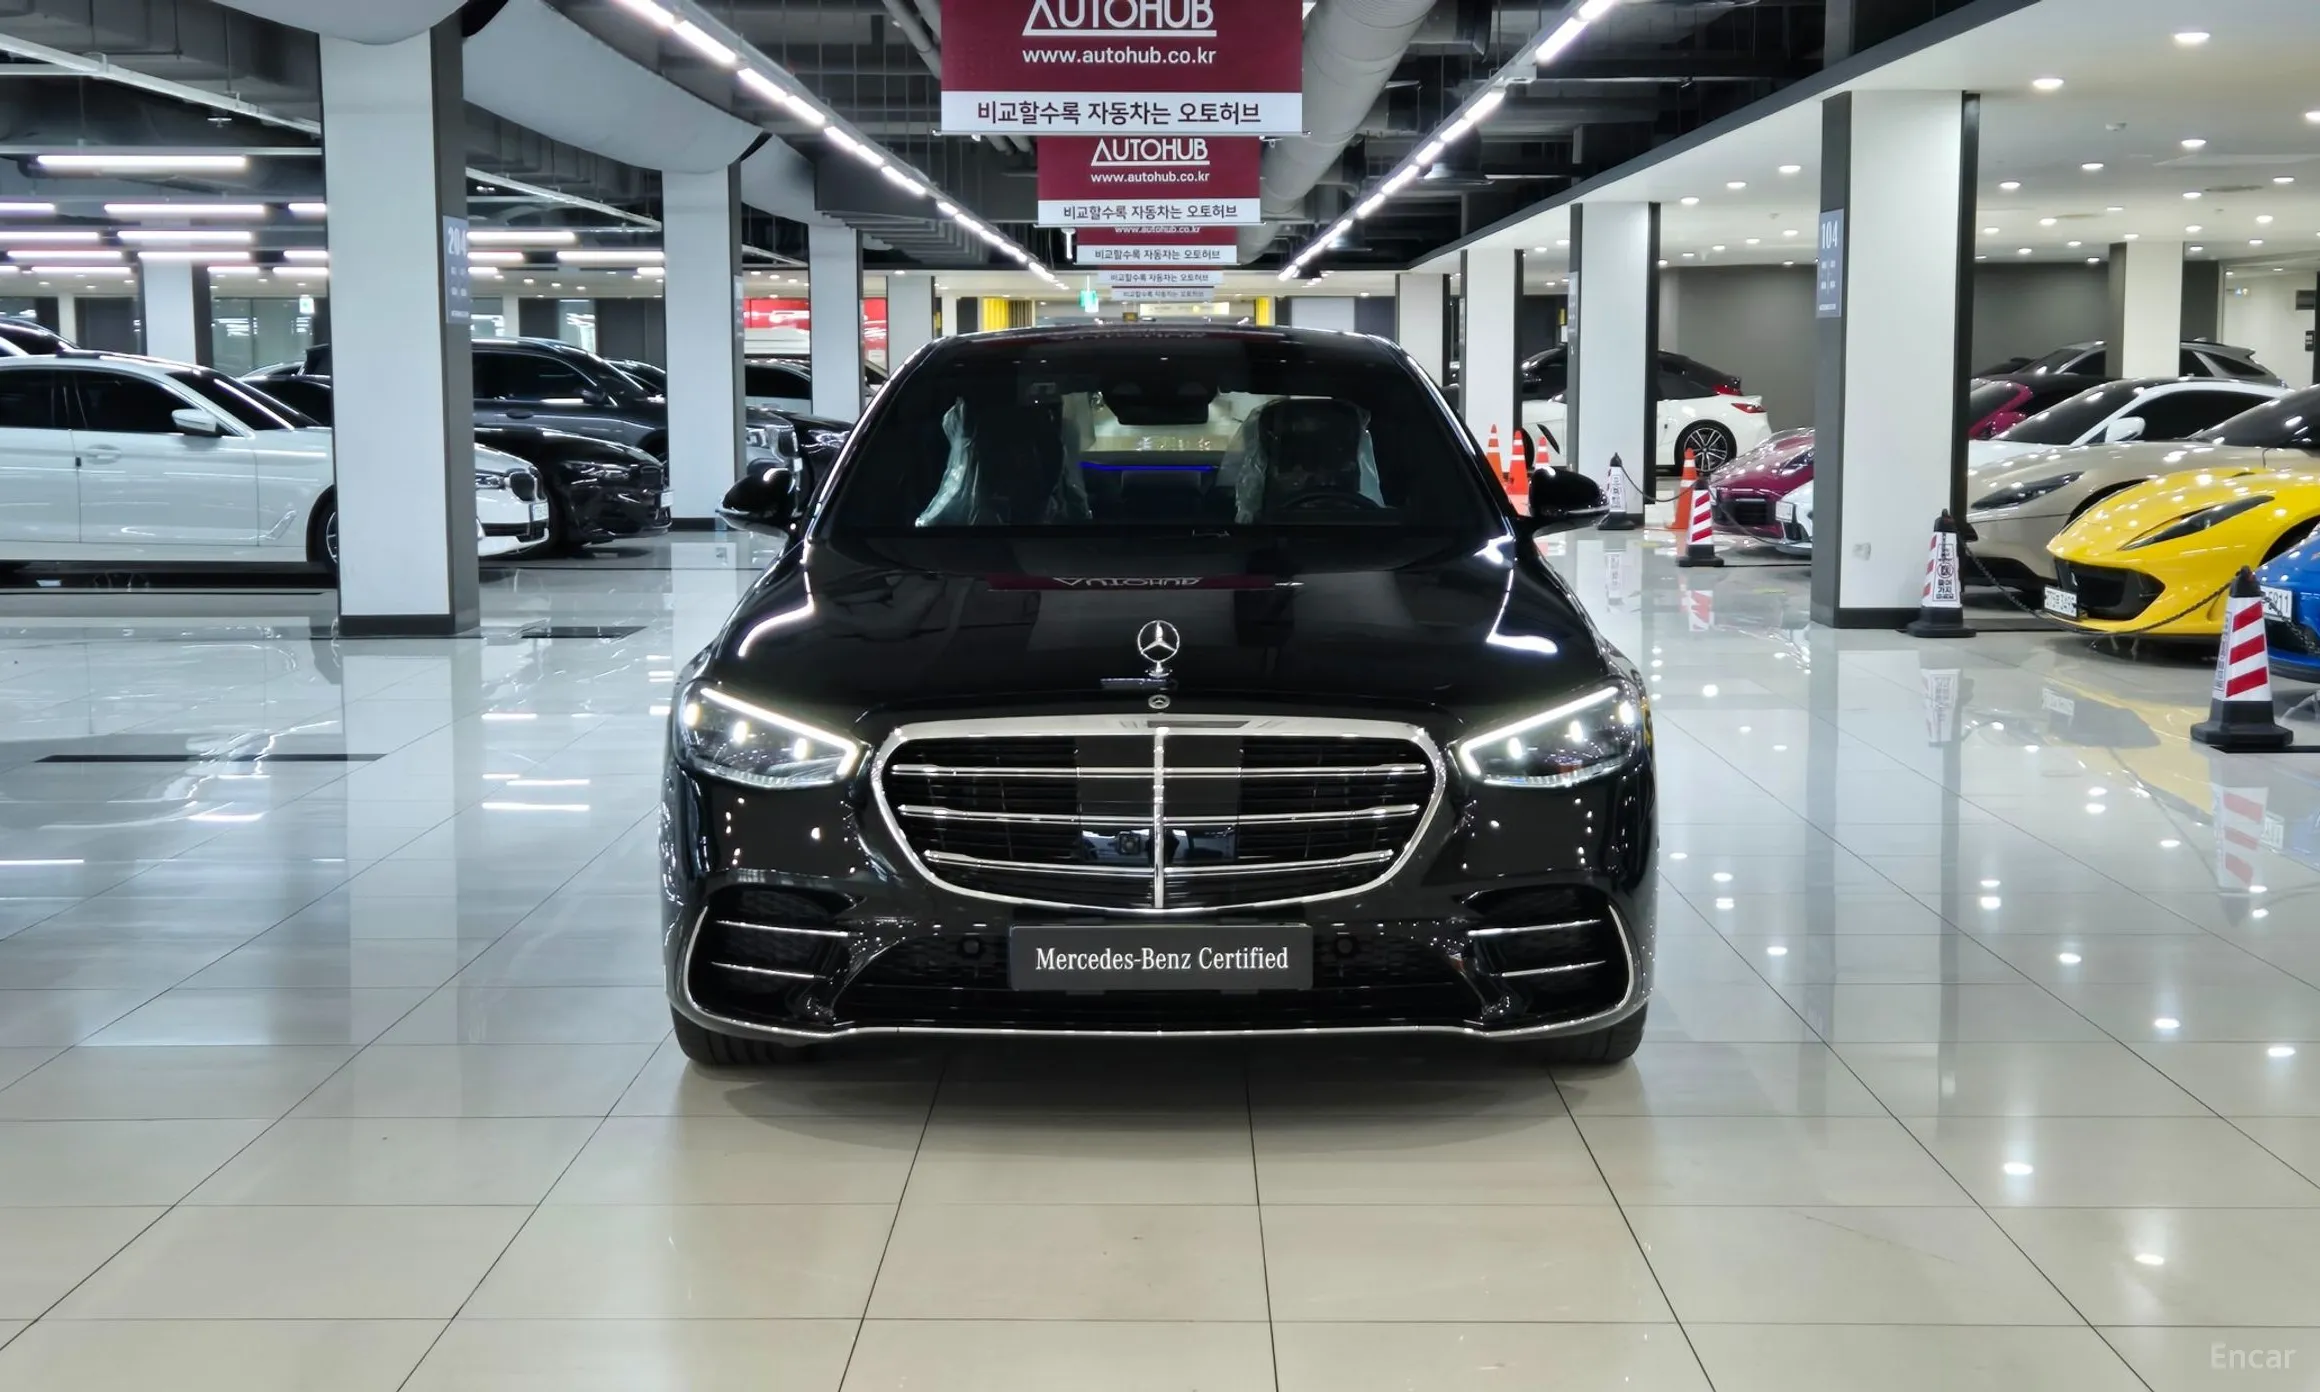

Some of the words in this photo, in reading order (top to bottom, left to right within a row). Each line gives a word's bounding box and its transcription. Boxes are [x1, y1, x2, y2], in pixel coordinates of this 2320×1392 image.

[1022, 0, 1217, 36] AUTOHUB
[1022, 46, 1216, 64] www.autohub.co.kr
[978, 101, 1081, 125] 비교할수록
[1088, 101, 1171, 125] 자동차는
[1178, 102, 1261, 124] 오토허브
[1091, 138, 1209, 166] AUTOHUB
[1091, 171, 1210, 183] www.autohub.co.kr
[1063, 205, 1127, 220] 비교할수록
[1132, 205, 1183, 220] 자동차는
[1187, 205, 1238, 219] 오토허브
[448, 226, 467, 257] 204
[1822, 220, 1838, 249] 104
[1095, 249, 1140, 260] 비교할수록
[1144, 249, 1180, 260] 자동차는
[1184, 249, 1220, 260] 오토허브
[1035, 948, 1192, 970] Mercedes-Benz
[1199, 947, 1289, 970] Certified
